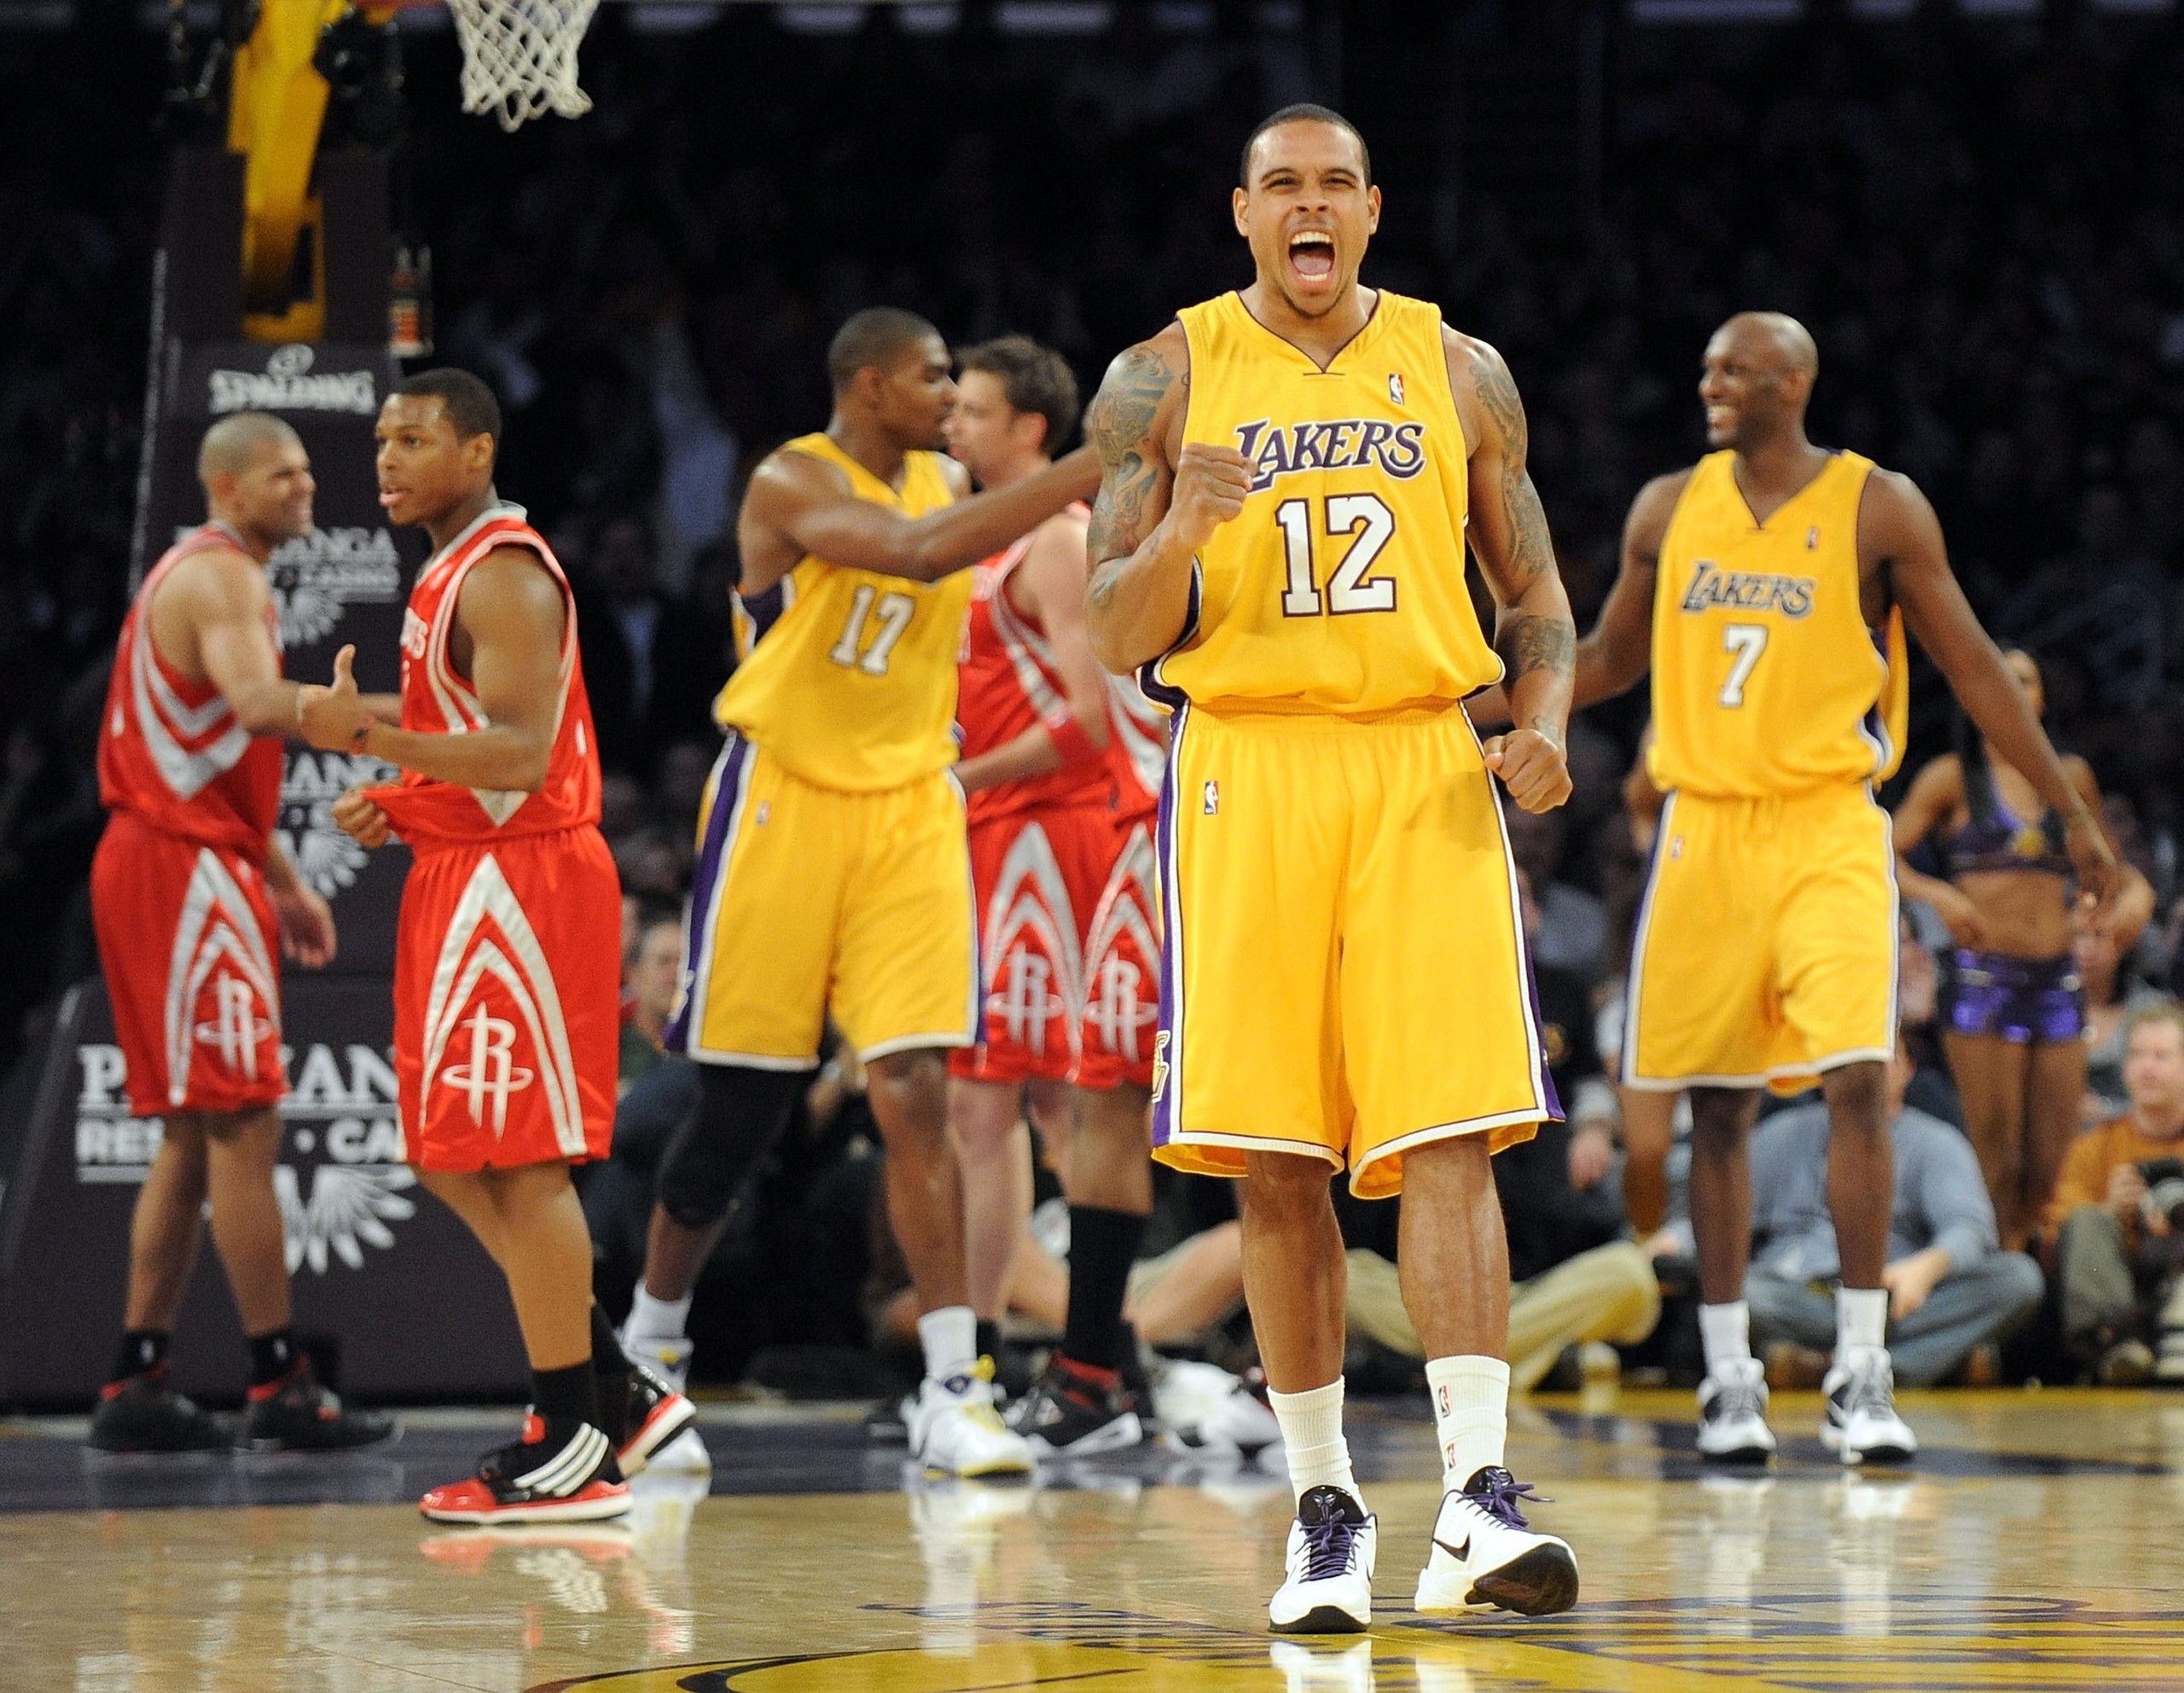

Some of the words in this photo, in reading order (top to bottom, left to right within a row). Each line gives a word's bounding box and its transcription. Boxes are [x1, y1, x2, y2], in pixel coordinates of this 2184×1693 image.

[210, 369, 375, 414] SPALDING
[1234, 419, 1427, 495] LAKERS
[1275, 492, 1397, 617] 12
[1682, 559, 1818, 620] LAKERS
[830, 583, 916, 675] 17
[1719, 623, 1769, 708] 7
